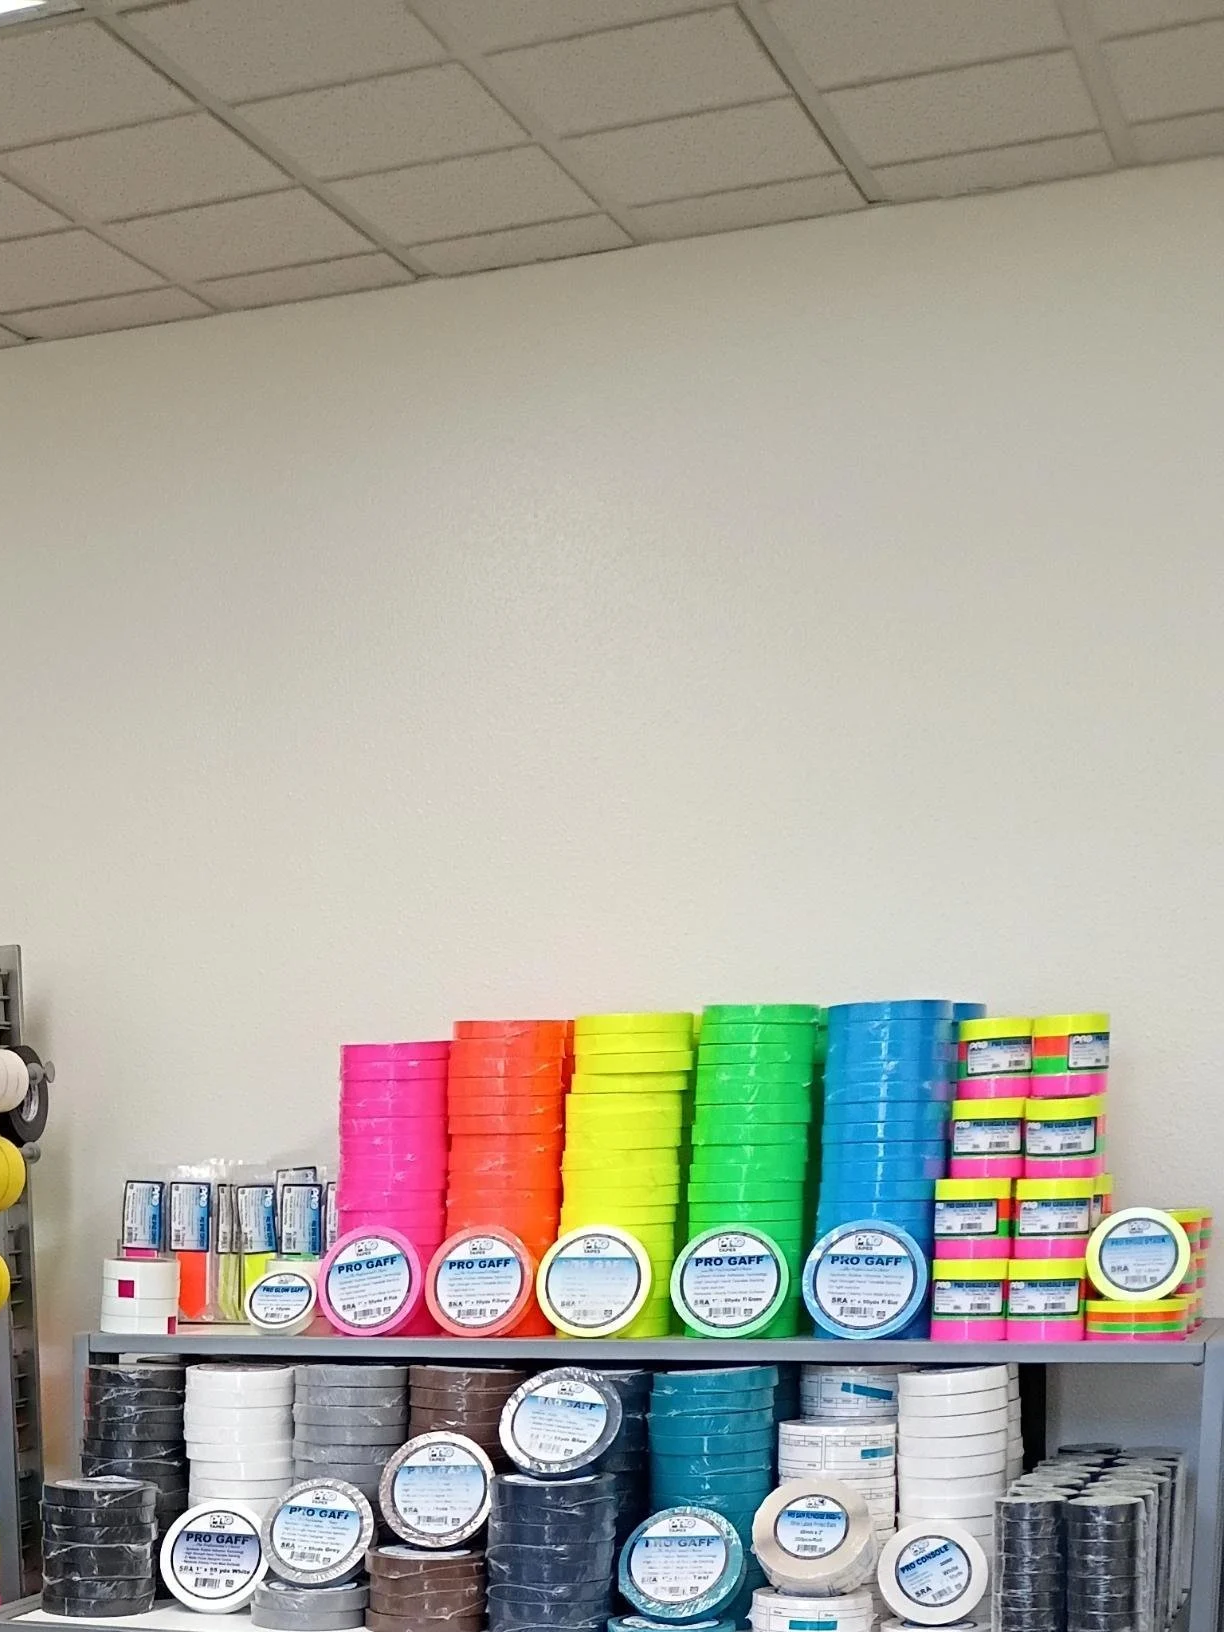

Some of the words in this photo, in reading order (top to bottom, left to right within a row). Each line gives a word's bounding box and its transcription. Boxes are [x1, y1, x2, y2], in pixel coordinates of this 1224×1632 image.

[338, 1263, 362, 1274] PRO
[366, 1256, 398, 1269] GAFF
[449, 1261, 475, 1270] PRO
[478, 1258, 511, 1269] GAFF
[695, 1257, 724, 1267] PRO
[727, 1255, 765, 1266] GAFF
[830, 1255, 860, 1265] PRO
[865, 1256, 902, 1266] GAFF
[186, 1533, 212, 1543] PRO
[216, 1534, 249, 1545] GAFF
[678, 1538, 715, 1548] GAFF
[900, 1561, 916, 1574] PRO
[916, 1543, 950, 1566] CONSOLE
[915, 1586, 932, 1598] SRA
